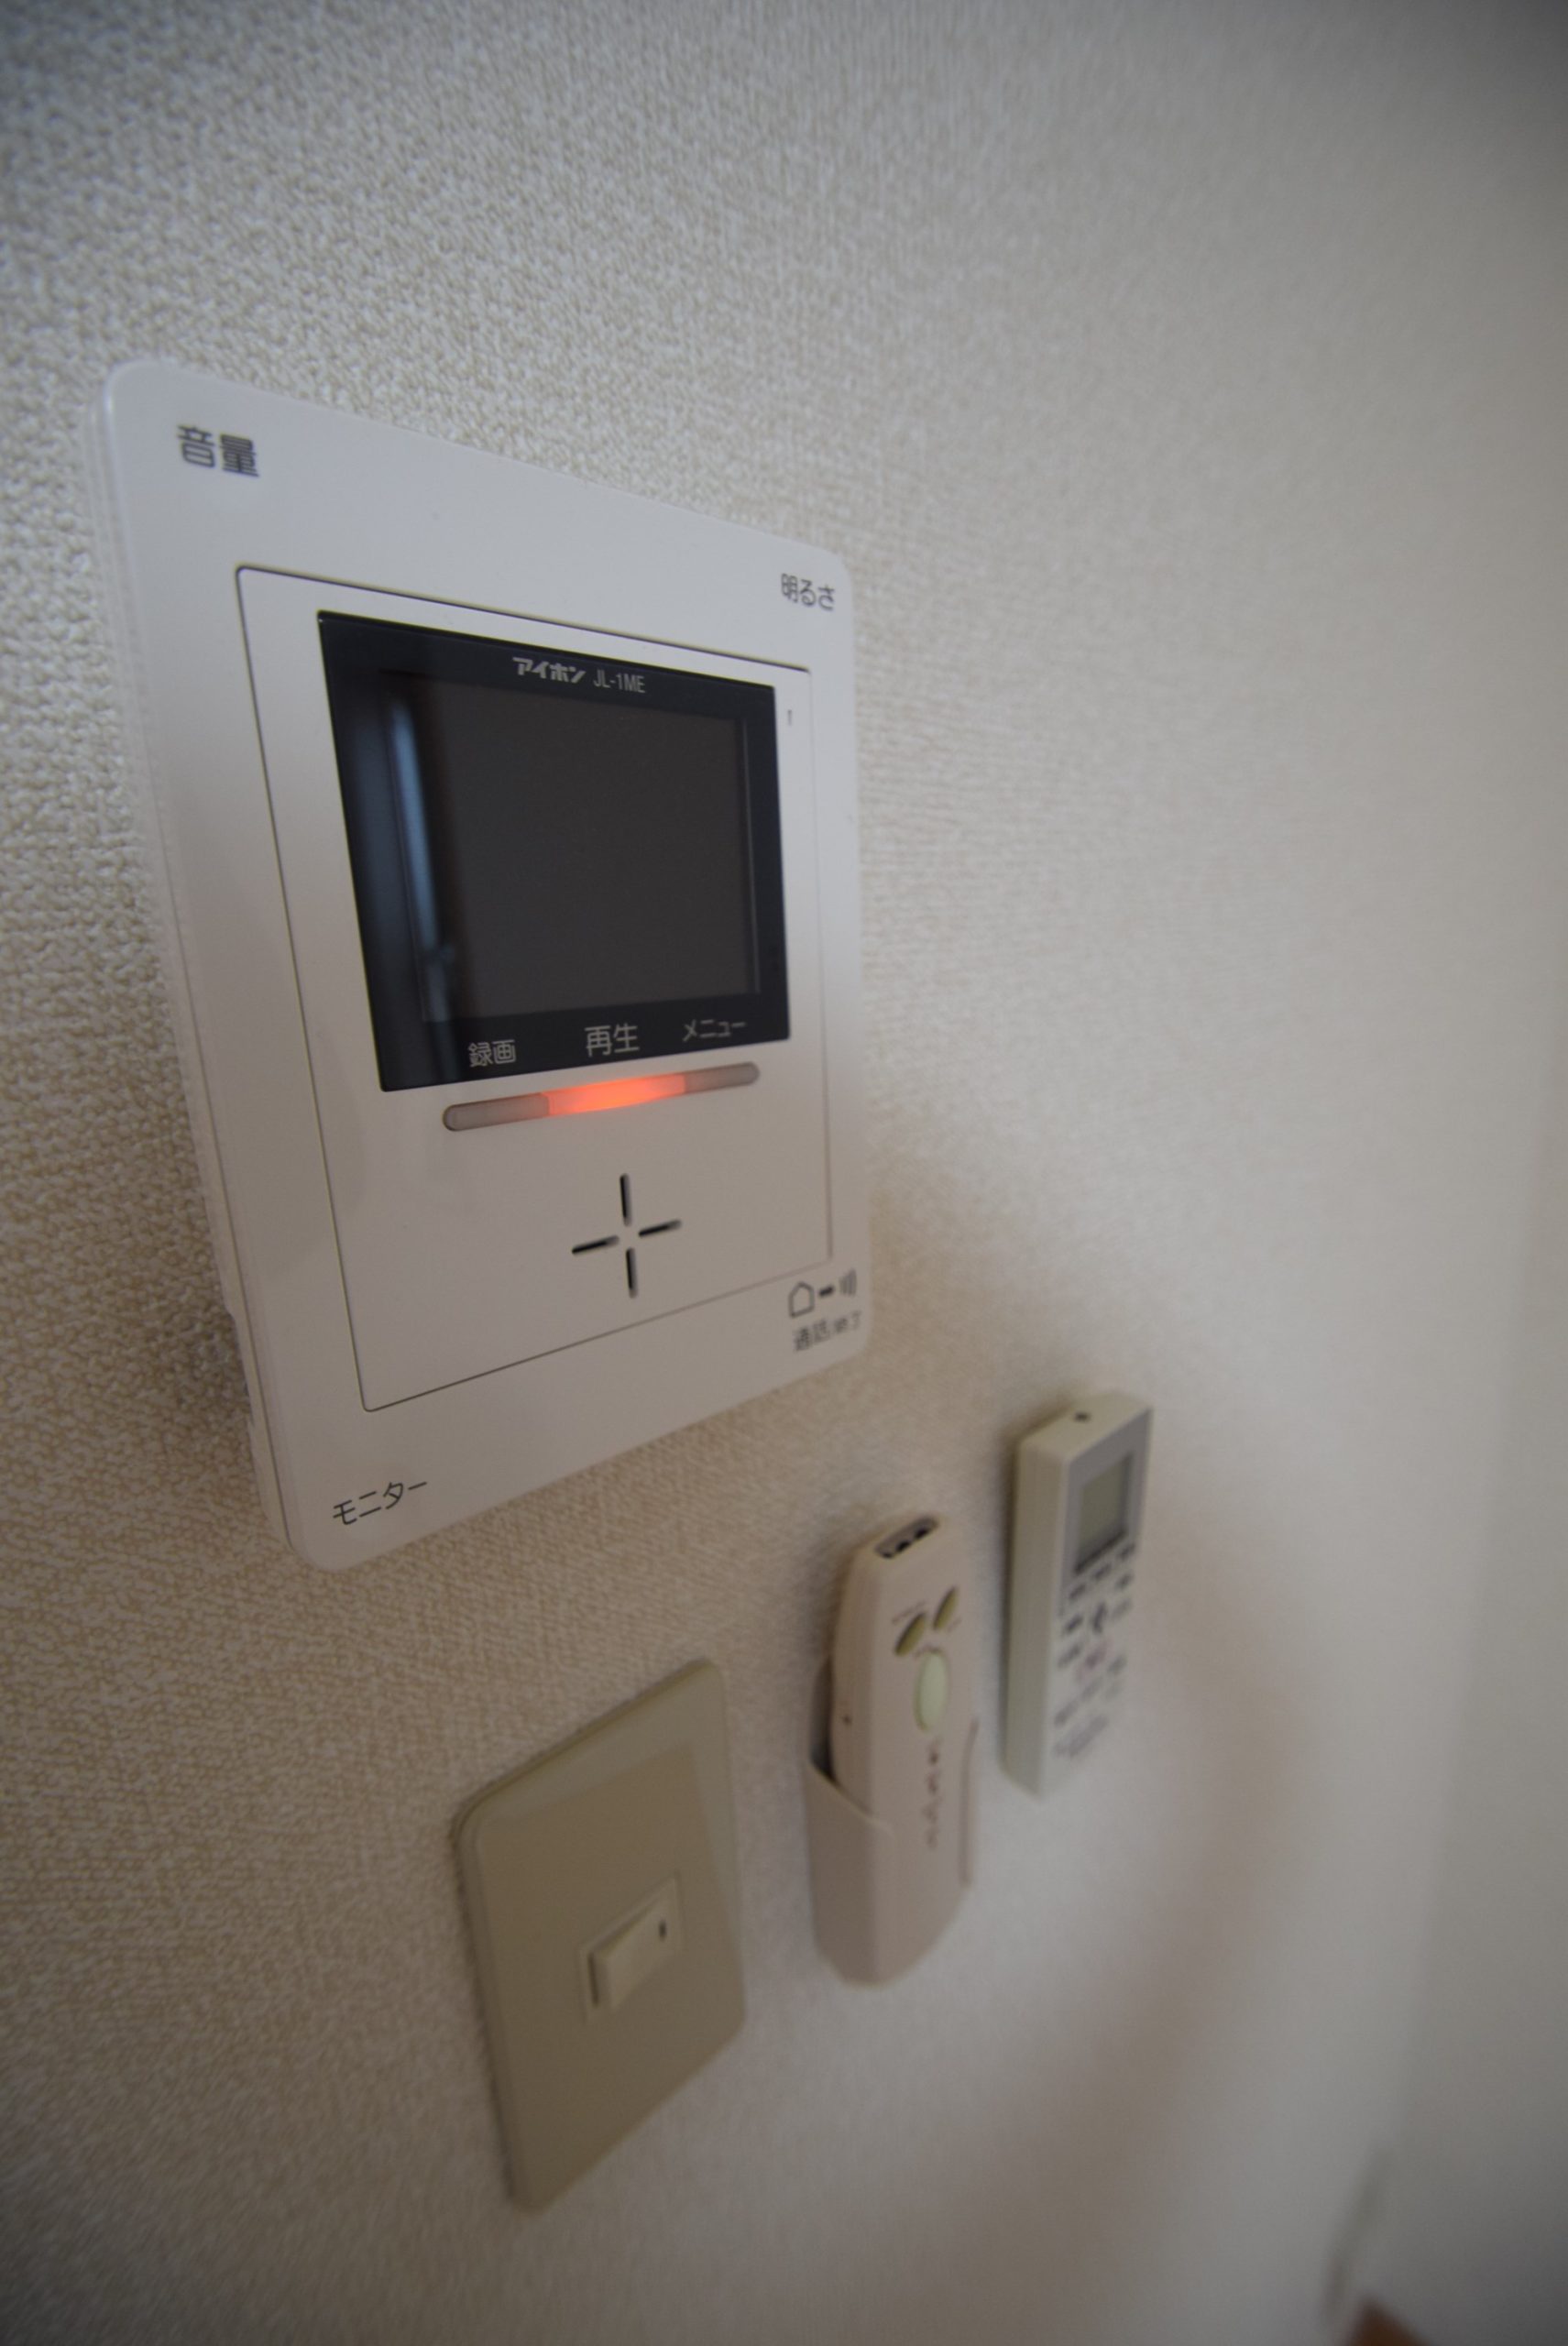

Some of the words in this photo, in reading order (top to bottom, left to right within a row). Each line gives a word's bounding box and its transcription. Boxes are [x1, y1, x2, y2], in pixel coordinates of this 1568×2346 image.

[177, 424, 259, 477] 音量
[781, 573, 835, 610] 明るさ
[512, 656, 586, 684] アイホン
[594, 669, 645, 693] JL-1ME
[585, 1023, 640, 1058] 再生
[682, 1019, 746, 1042] メニュー
[467, 1039, 517, 1068] 録画
[333, 1481, 427, 1525] モニター
